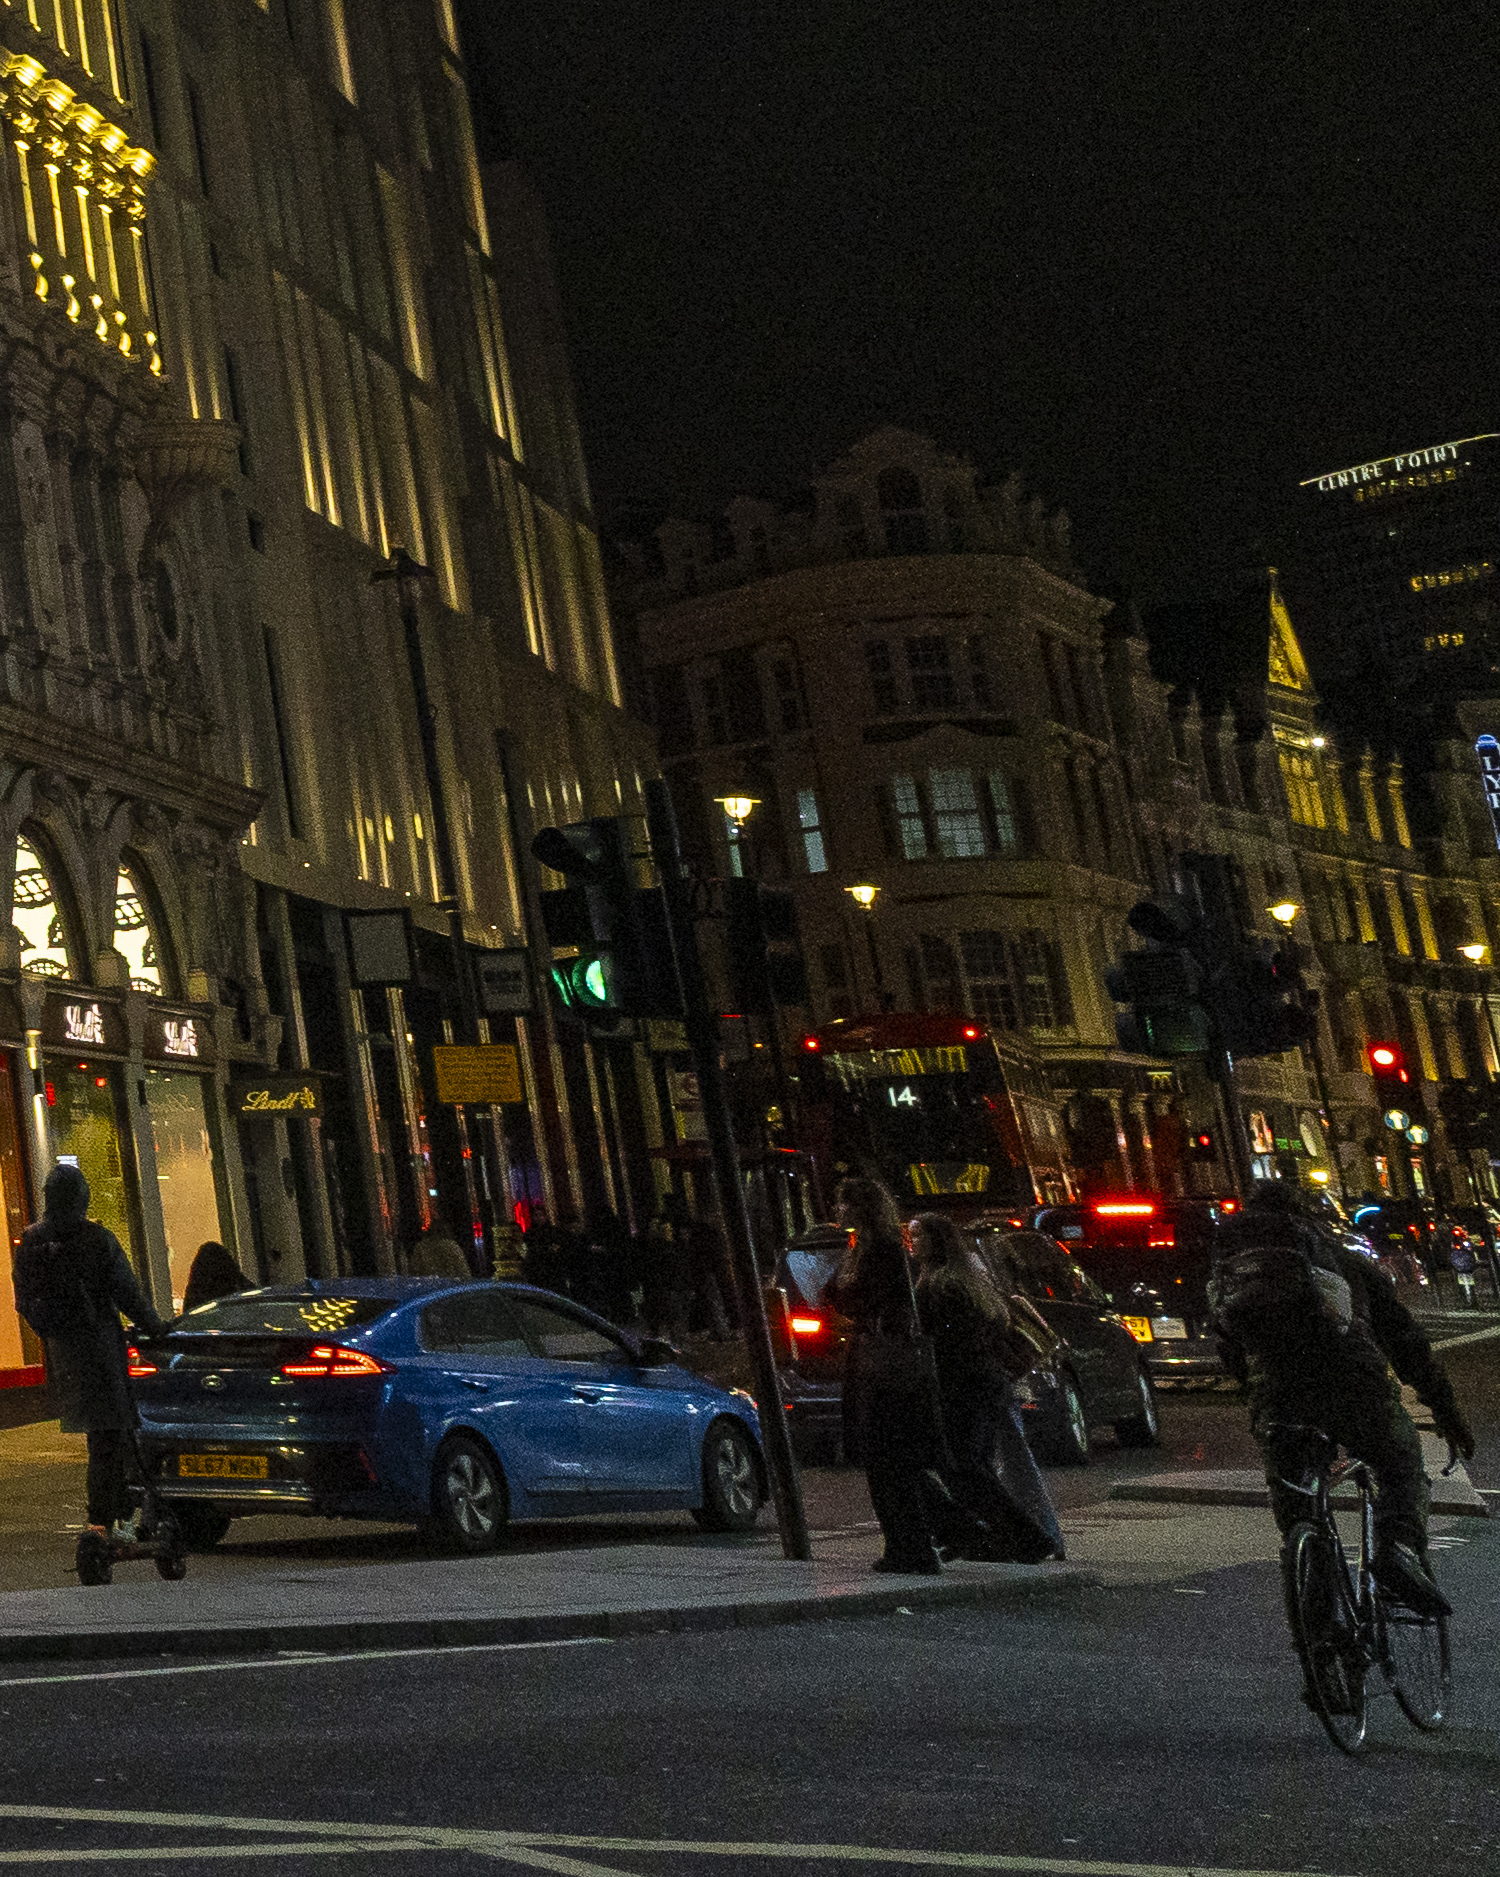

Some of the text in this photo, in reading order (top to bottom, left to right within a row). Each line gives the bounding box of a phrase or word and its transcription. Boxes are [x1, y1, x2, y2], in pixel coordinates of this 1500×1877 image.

[1318, 444, 1459, 492] CENTRE POINT
[241, 1090, 300, 1111] Lindt
[888, 1085, 919, 1108] 14
